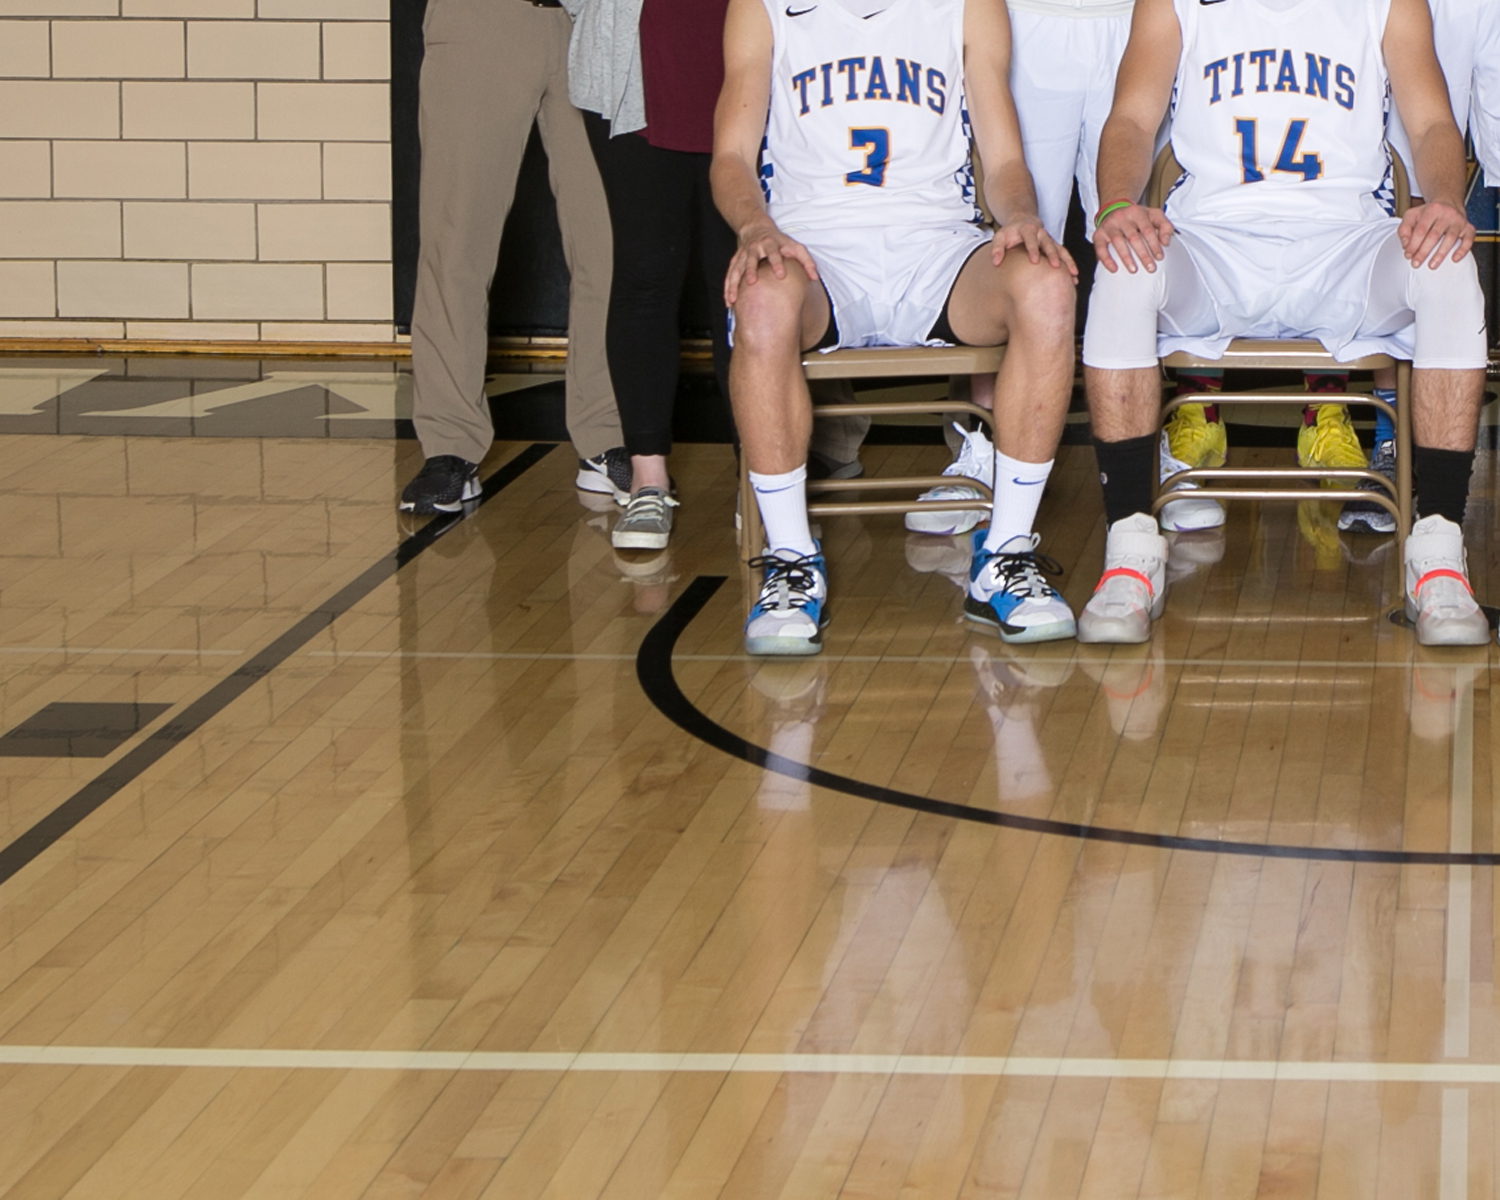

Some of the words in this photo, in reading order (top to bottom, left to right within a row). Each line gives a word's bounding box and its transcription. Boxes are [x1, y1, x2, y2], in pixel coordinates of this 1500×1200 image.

[791, 56, 946, 116] TITANS
[1203, 48, 1356, 111] TITANS
[842, 125, 891, 188] 3
[1232, 115, 1324, 184] 14
